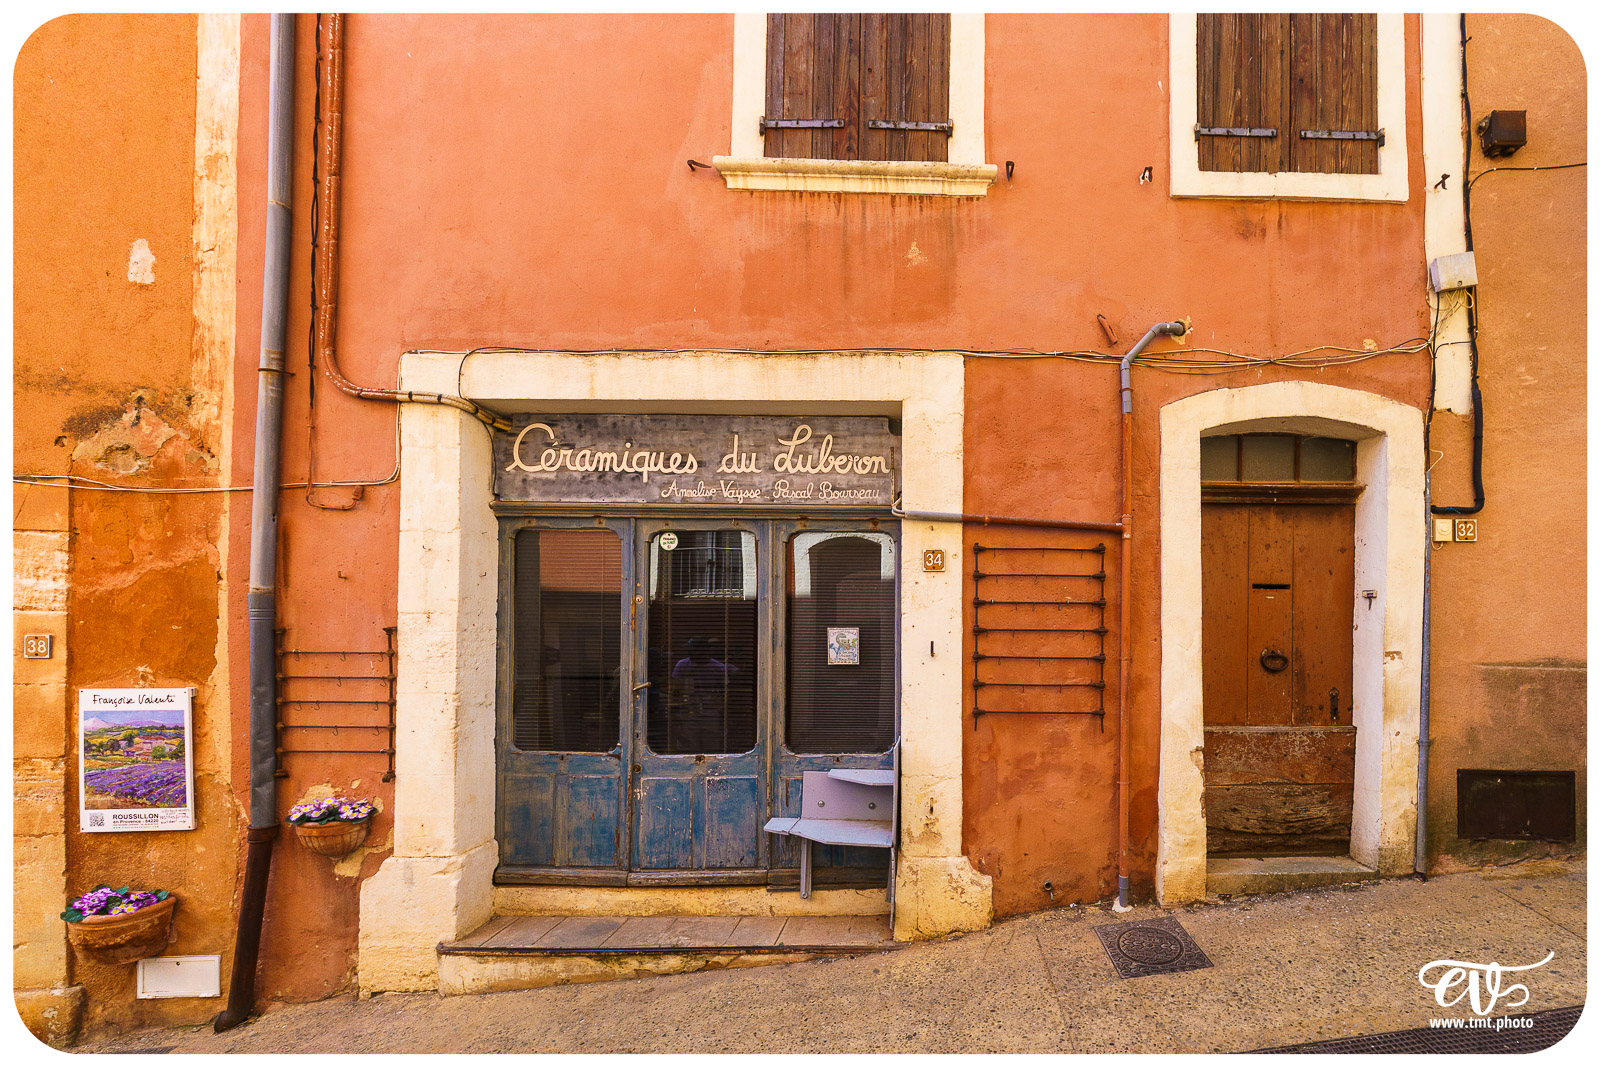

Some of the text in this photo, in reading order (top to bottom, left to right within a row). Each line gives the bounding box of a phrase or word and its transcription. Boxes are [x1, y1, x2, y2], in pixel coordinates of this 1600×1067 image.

[505, 422, 890, 483] Céramiques du Luberon
[661, 479, 717, 498] Annelise
[720, 480, 761, 504] Vaysse
[772, 479, 814, 499] Pascal
[818, 481, 880, 499] Bourseau
[1458, 523, 1474, 536] 32
[926, 553, 942, 566] 34
[27, 640, 47, 653] 38
[92, 694, 136, 707] Françoise
